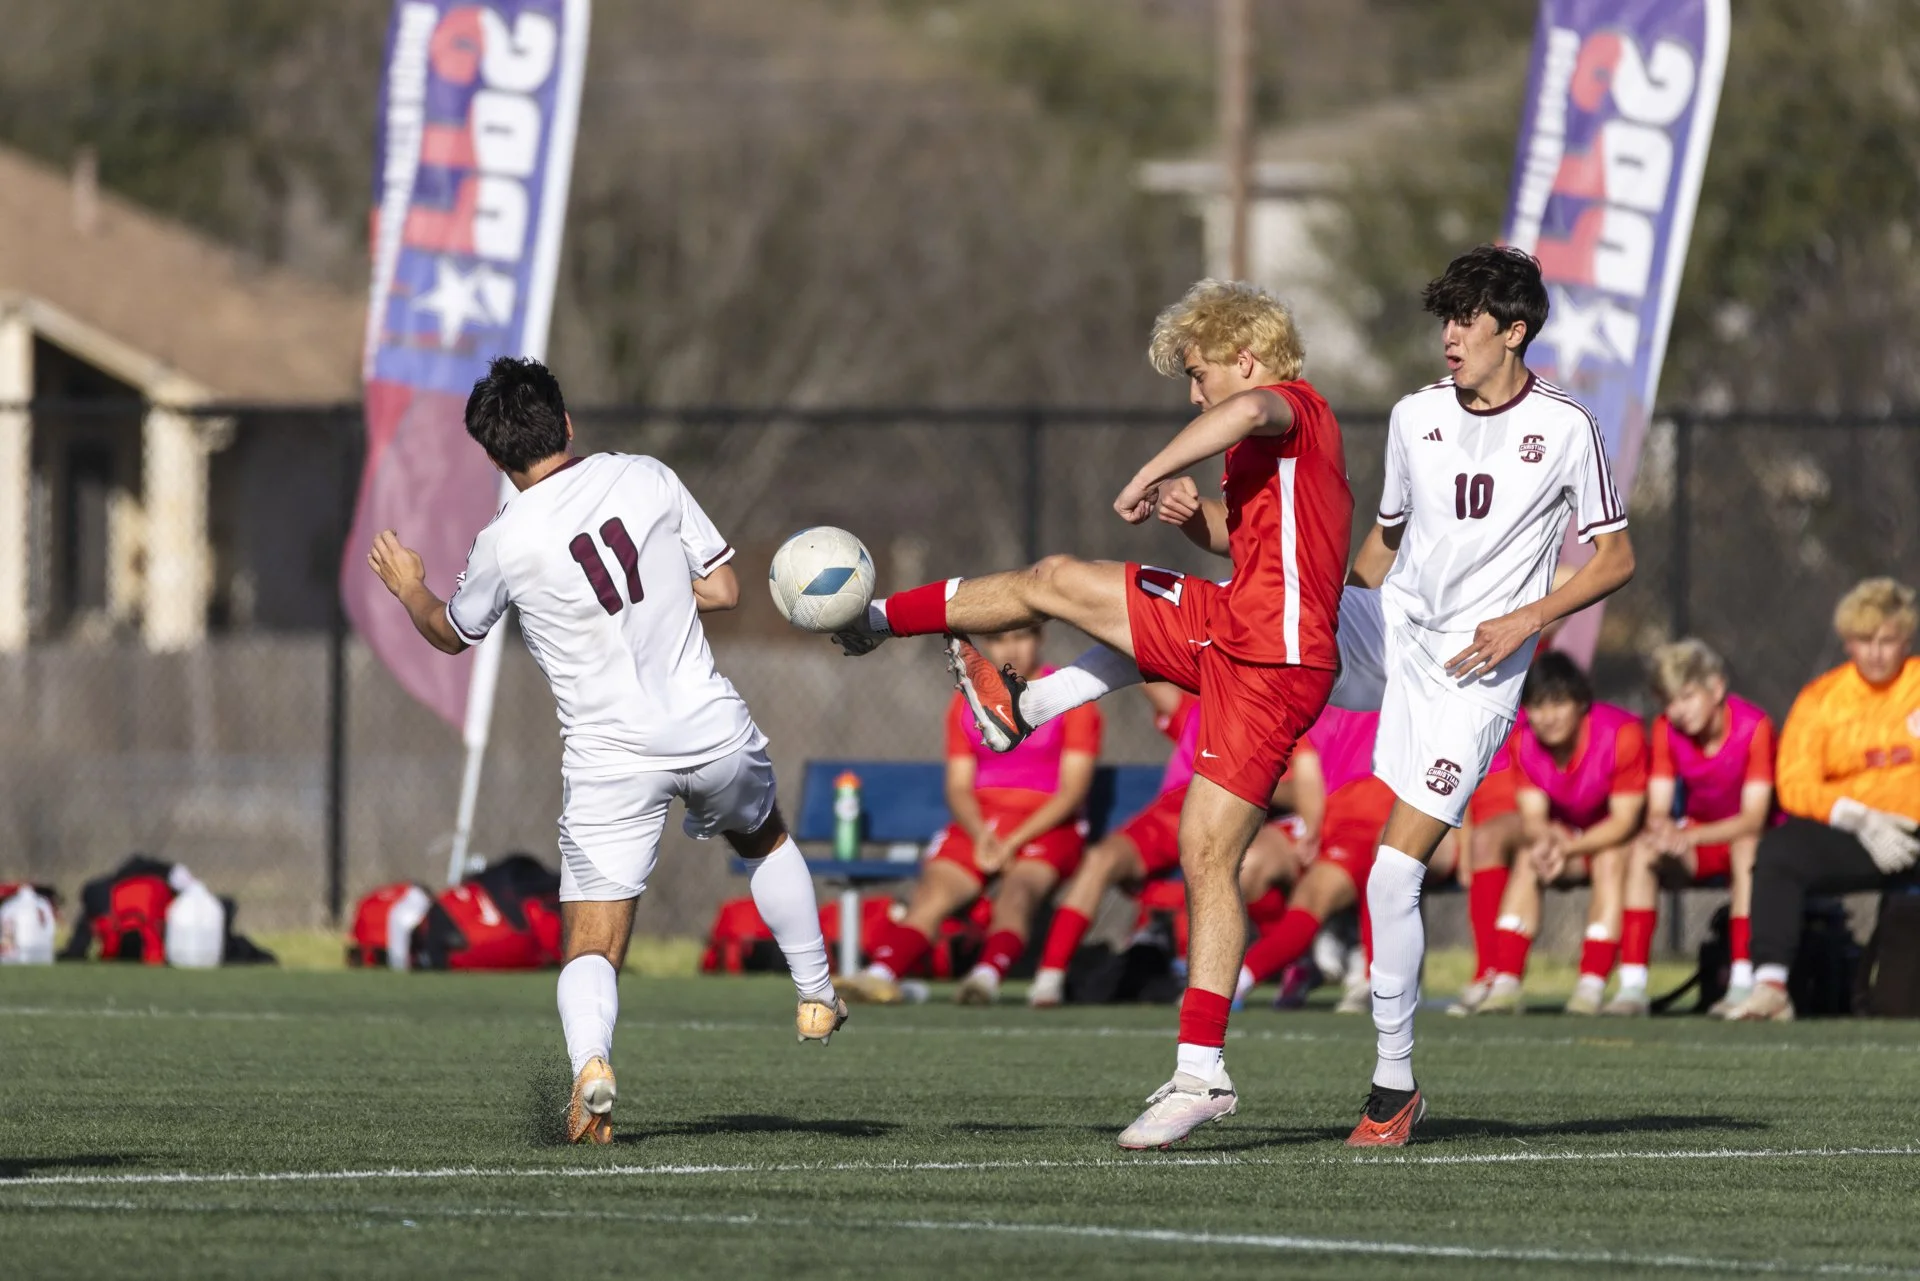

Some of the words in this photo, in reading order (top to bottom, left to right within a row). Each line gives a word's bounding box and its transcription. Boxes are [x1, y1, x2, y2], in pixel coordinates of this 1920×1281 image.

[1454, 472, 1495, 521] 10
[568, 516, 645, 616] 11
[1427, 768, 1460, 788] CHRISTIAN
